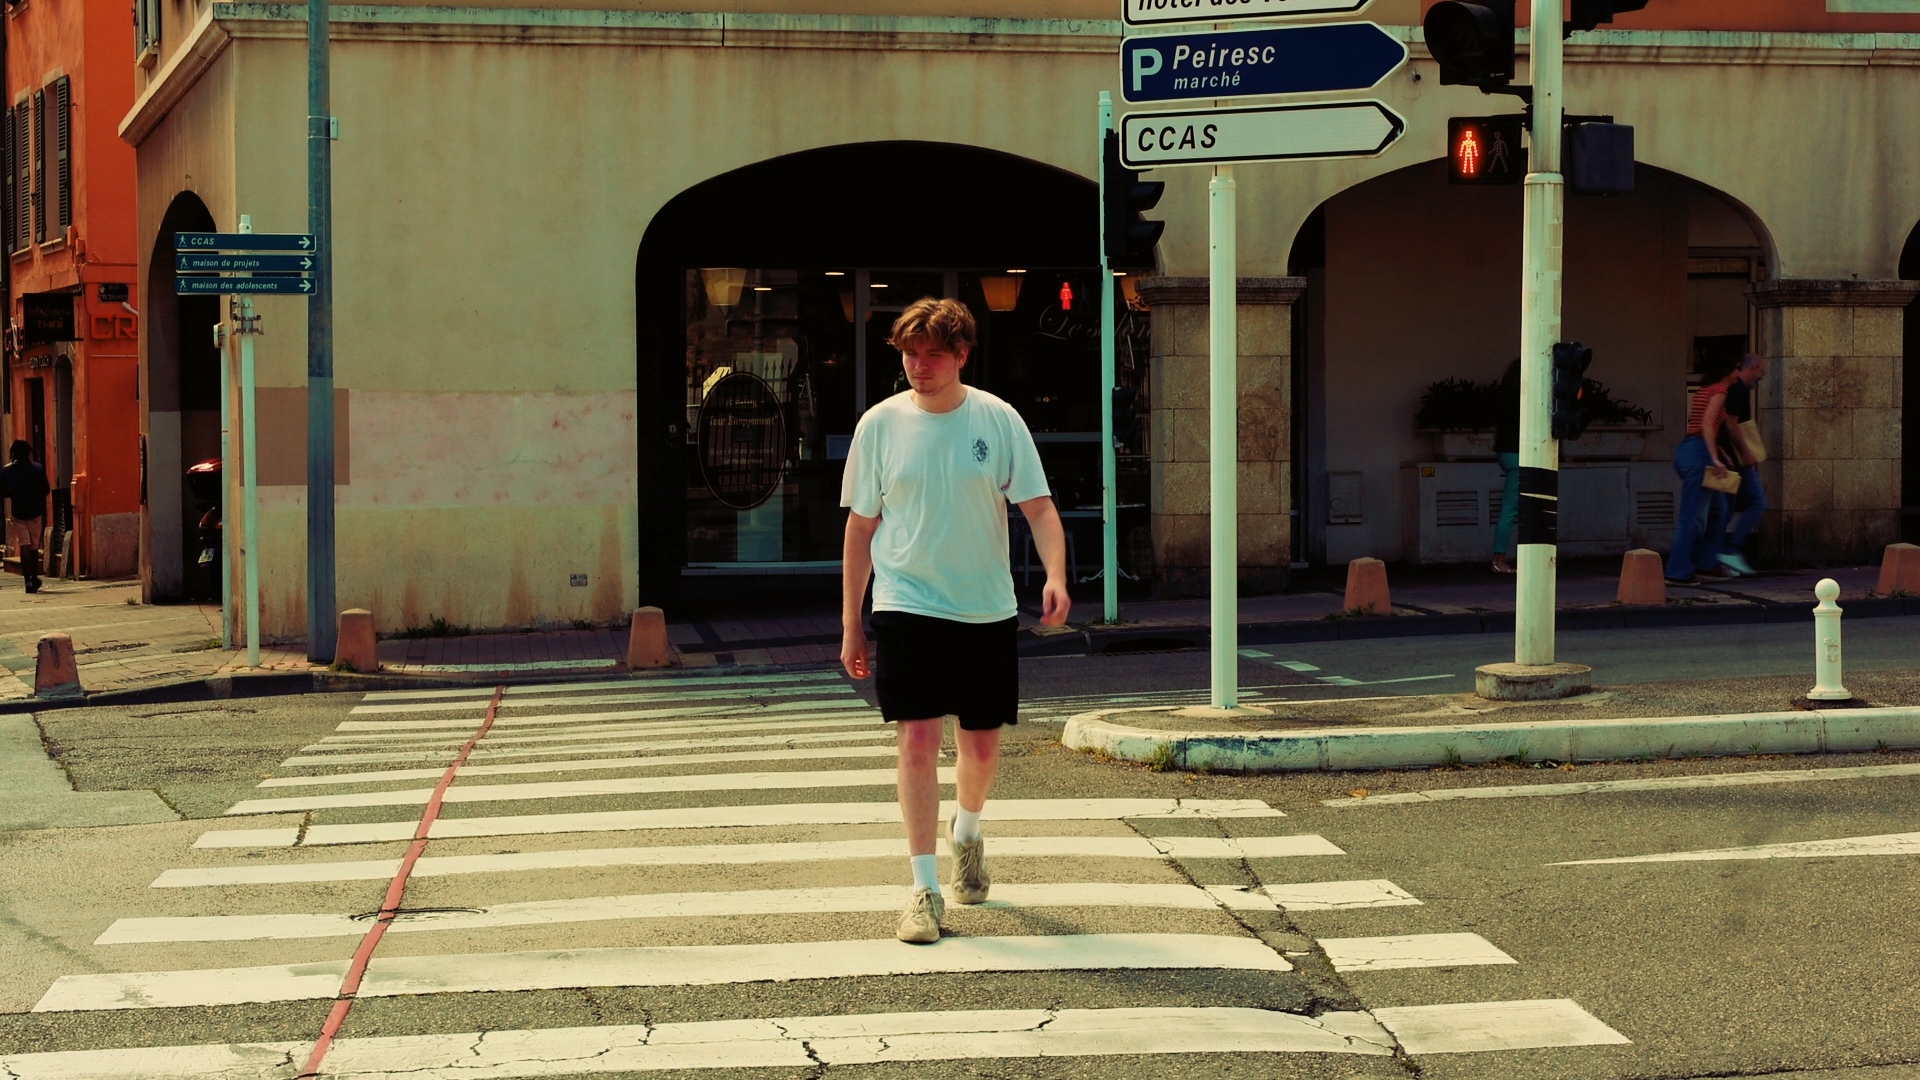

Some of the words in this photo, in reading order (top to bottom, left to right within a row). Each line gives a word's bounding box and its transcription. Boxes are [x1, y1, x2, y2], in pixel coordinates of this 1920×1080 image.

[1132, 48, 1163, 91] P
[1173, 43, 1276, 70] Peiresc
[1173, 70, 1241, 90] marché
[1138, 124, 1218, 151] CCAS
[191, 237, 215, 246] CCAS
[192, 259, 219, 267] maison
[221, 258, 231, 267] de
[233, 259, 260, 269] projets
[191, 281, 218, 289] maison
[220, 281, 233, 289] des
[235, 281, 278, 289] adolescents
[1033, 303, 1082, 340] Le
